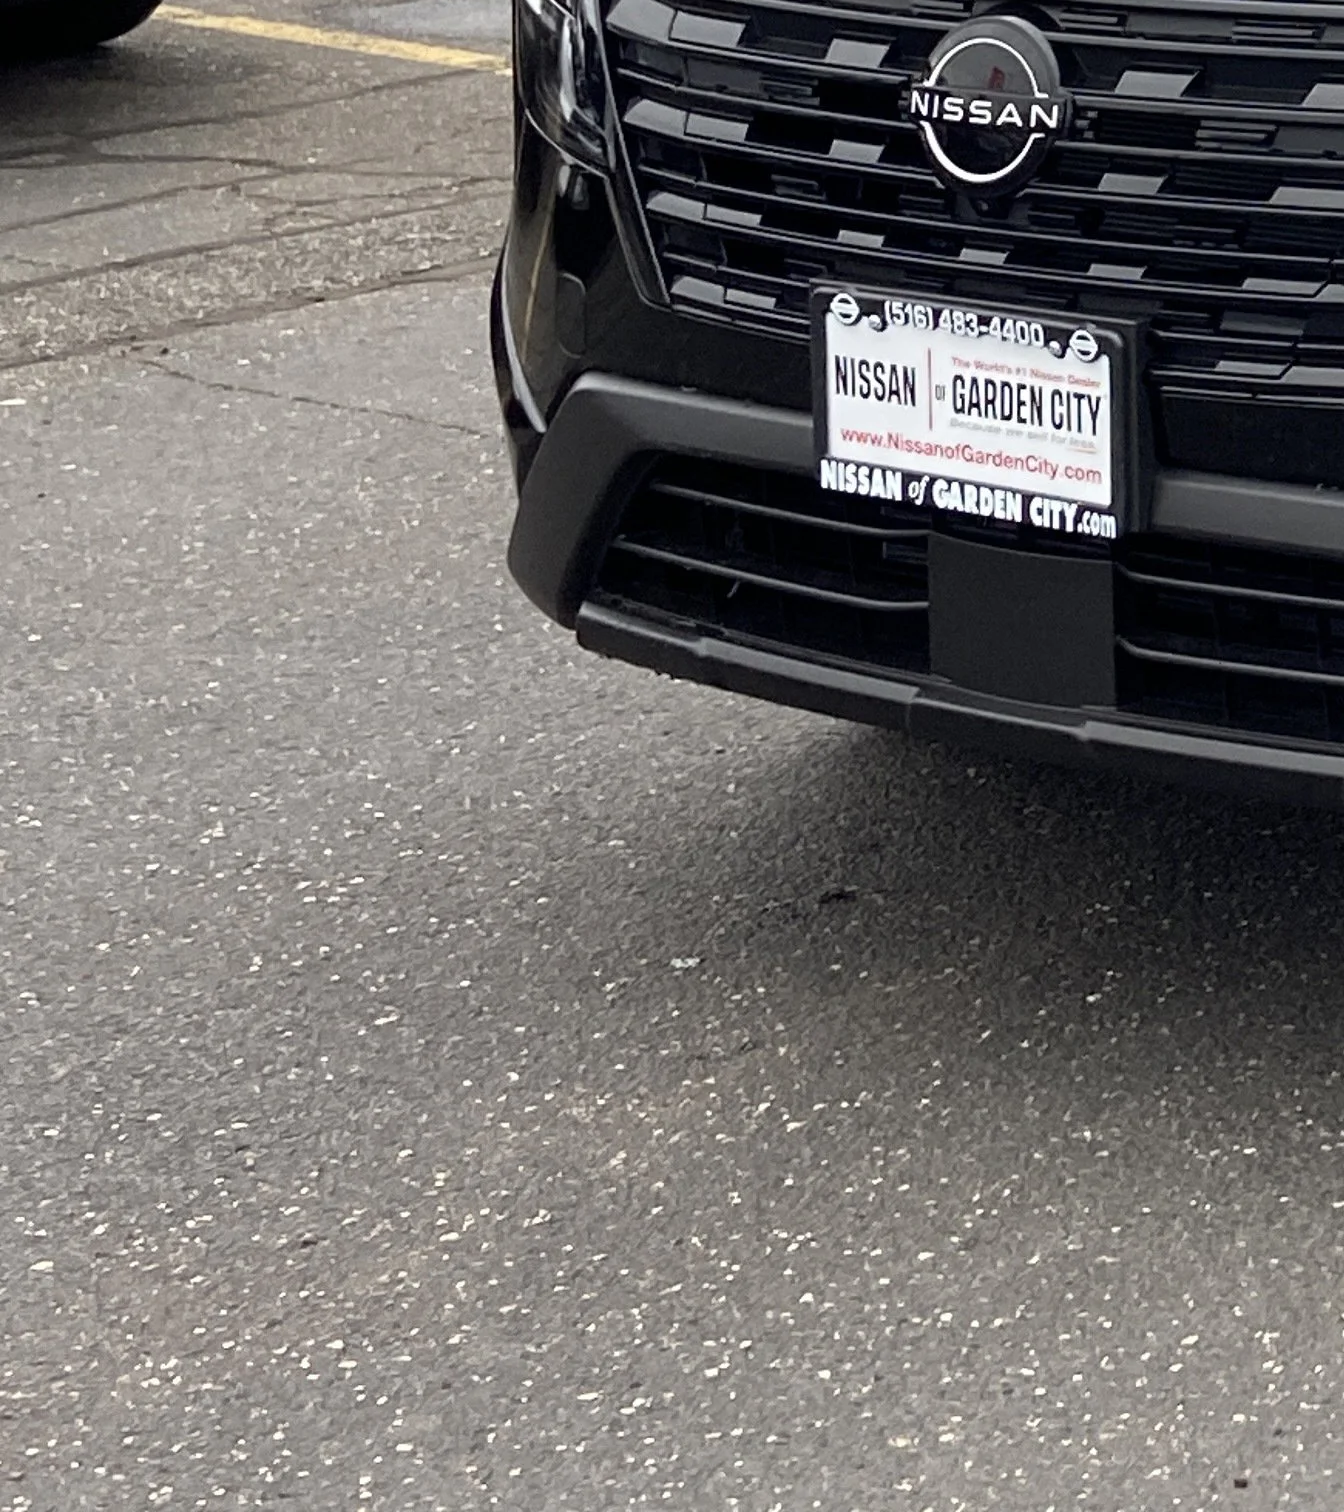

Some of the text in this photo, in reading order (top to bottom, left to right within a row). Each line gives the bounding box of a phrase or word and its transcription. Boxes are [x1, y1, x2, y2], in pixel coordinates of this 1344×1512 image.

[910, 90, 1059, 129] NISSAN
[884, 300, 1045, 348] (516) 483-4400
[834, 354, 917, 408] NISSAN
[952, 373, 1043, 427] GARDEN
[1050, 388, 1101, 436] CITY
[840, 426, 1103, 485] www.NissanofGardenCity.com
[820, 458, 1118, 539] NISSAN of GARDEN CITY.com
